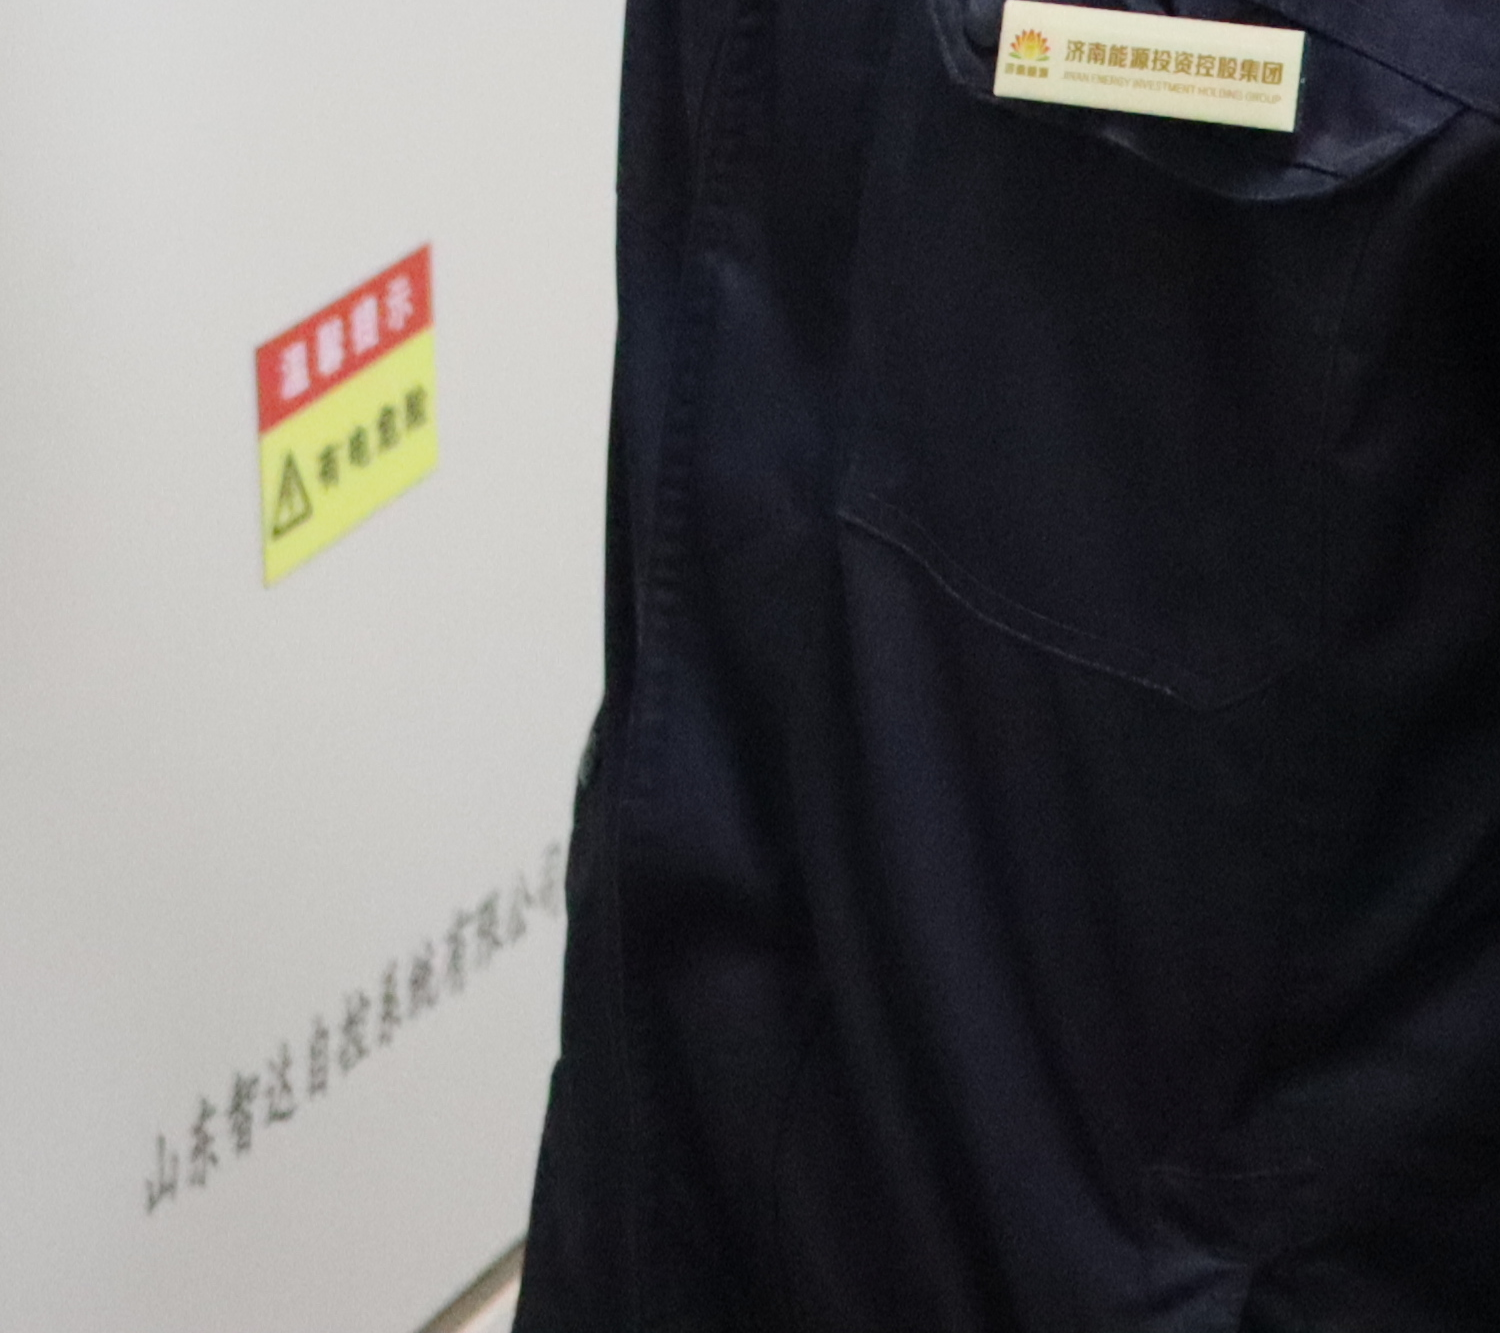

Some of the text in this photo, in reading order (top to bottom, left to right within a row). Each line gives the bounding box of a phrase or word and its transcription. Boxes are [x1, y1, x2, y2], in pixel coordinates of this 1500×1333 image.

[1065, 39, 1284, 85] 济南能源投资控股集团
